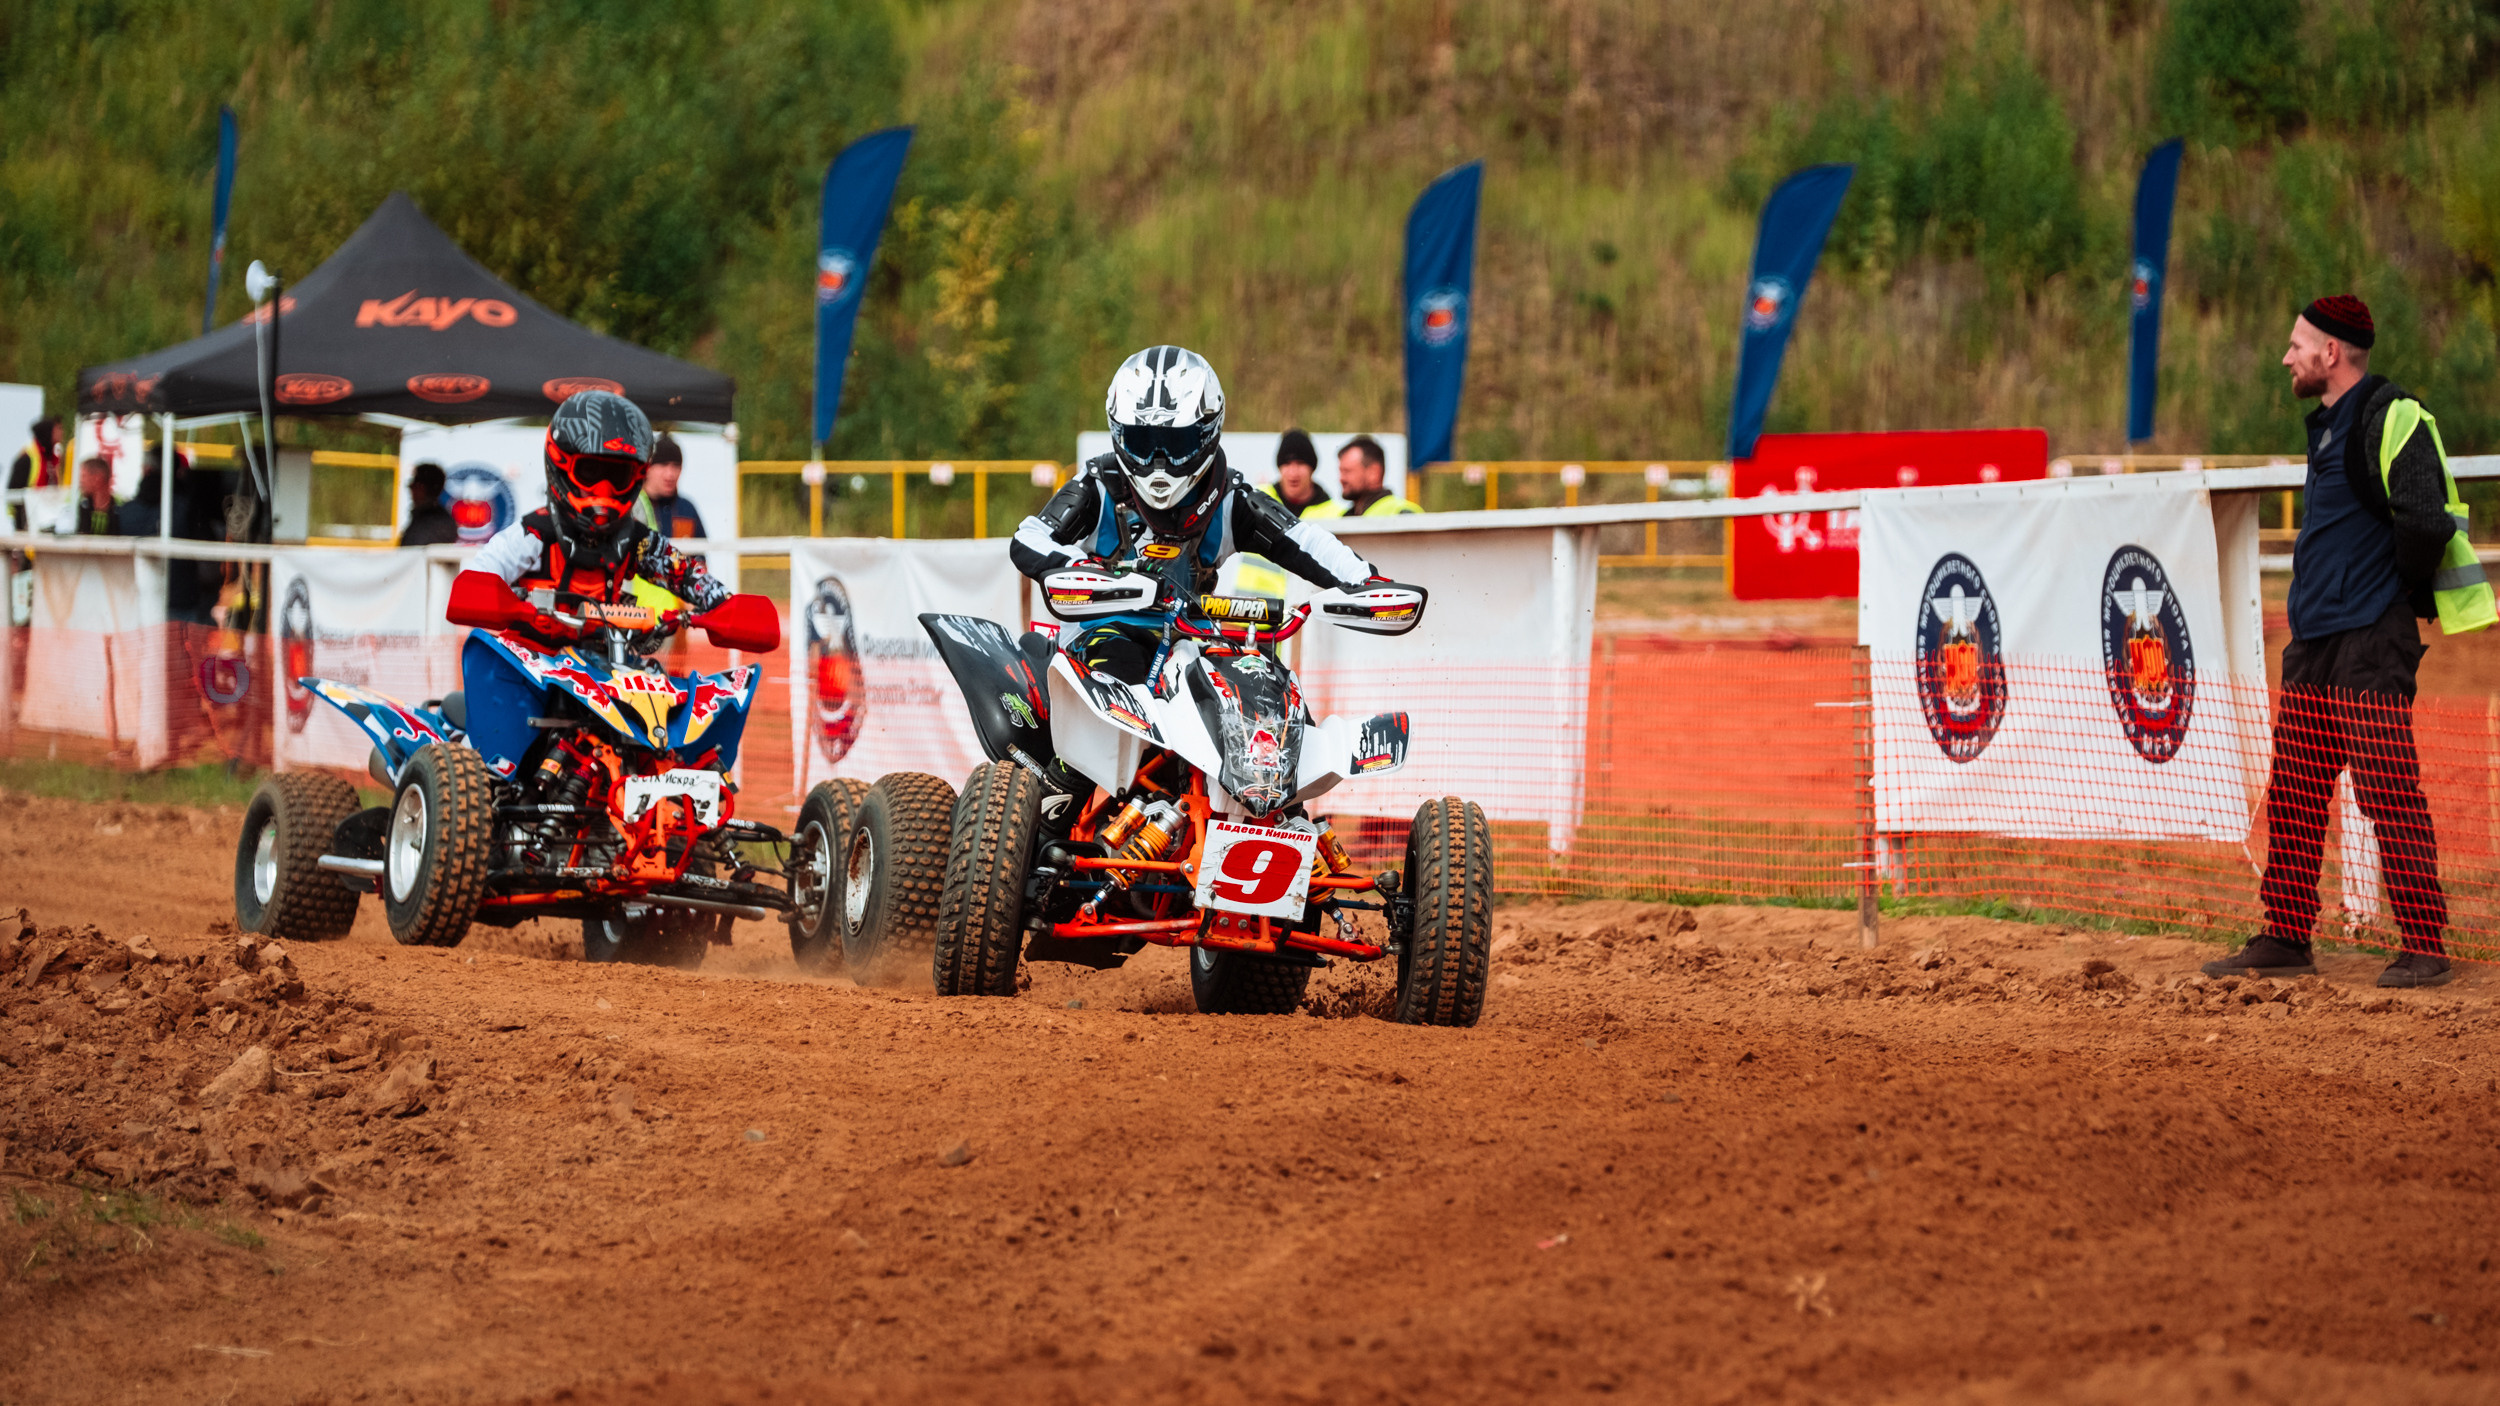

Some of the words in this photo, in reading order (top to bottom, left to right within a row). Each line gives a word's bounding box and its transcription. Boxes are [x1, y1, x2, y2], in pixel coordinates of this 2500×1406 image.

[355, 288, 518, 331] KAYO
[1143, 544, 1181, 559] 9
[2103, 551, 2162, 623] МОТОЦИКЛЕТНОГО
[2162, 582, 2189, 651] СПОРТА
[590, 608, 648, 618] RNTHAL
[1149, 653, 1165, 679] YAMAHA
[547, 804, 575, 812] YAMAHA
[1216, 822, 1263, 836] Авдеев
[1264, 828, 1313, 842] Кирилл
[1212, 839, 1302, 904] 9
